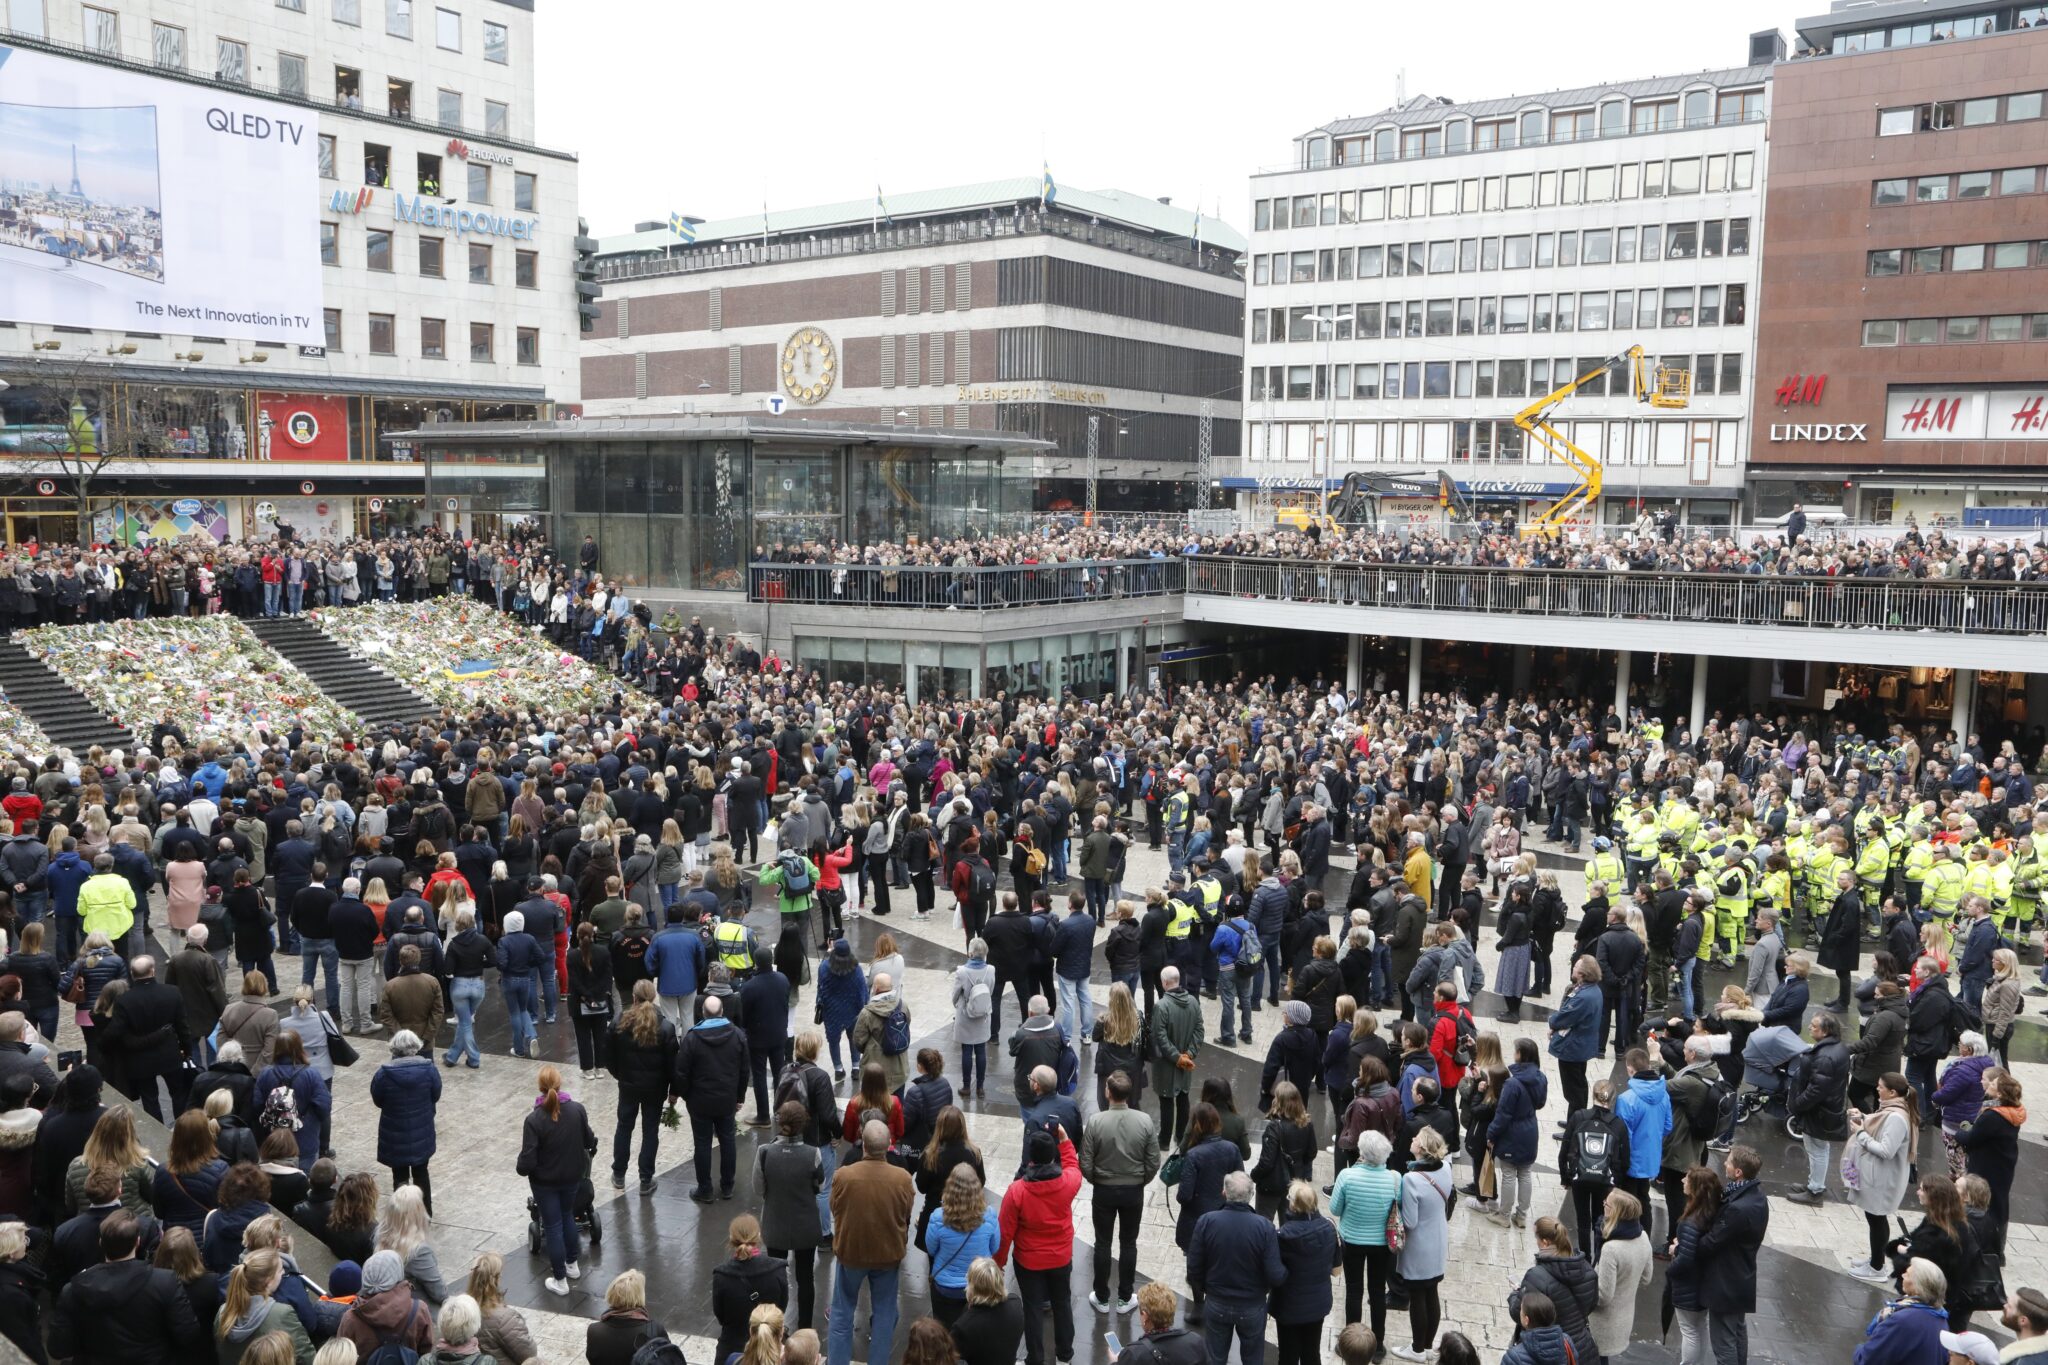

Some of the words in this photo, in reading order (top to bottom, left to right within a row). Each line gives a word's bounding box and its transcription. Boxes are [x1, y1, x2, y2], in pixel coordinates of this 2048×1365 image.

[206, 107, 271, 139] QLED
[275, 120, 303, 146] TV
[395, 191, 537, 240] Manpower
[136, 301, 163, 316] The
[167, 304, 201, 319] Next
[205, 308, 278, 326] Innovation
[280, 314, 292, 328] in
[294, 315, 310, 328] TV
[770, 398, 783, 412] T
[1011, 386, 1038, 401] CITY
[1775, 373, 1827, 406] H&M
[1901, 397, 1962, 432] H&M
[2011, 396, 2048, 431] H&
[1770, 423, 1867, 441] LINDEX
[1391, 483, 1421, 491] VOLVO
[1006, 662, 1037, 695] SL
